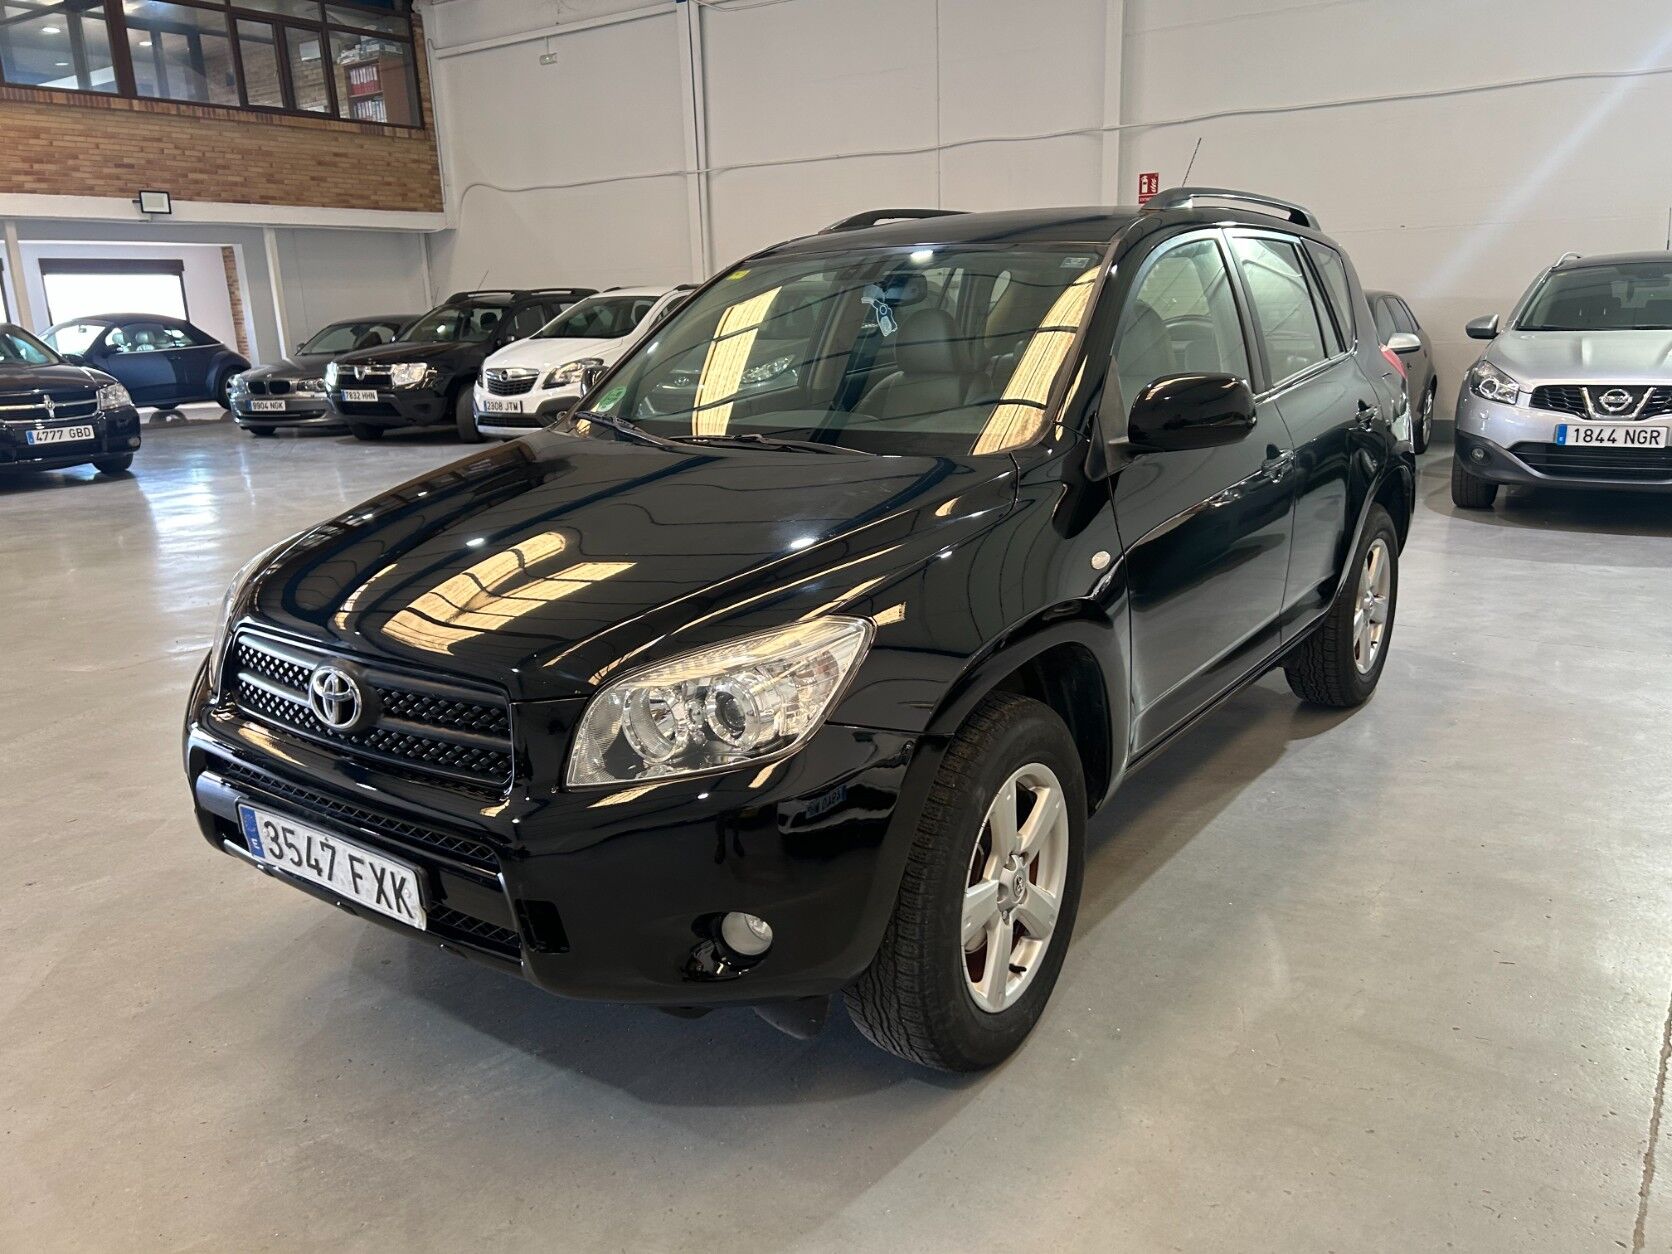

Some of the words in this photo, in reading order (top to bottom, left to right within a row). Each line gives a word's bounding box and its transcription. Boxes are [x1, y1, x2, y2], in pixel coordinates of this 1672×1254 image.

[487, 401, 503, 411] 2308
[505, 401, 518, 411] JTM
[36, 429, 64, 442] 4777
[68, 426, 92, 439] GBD
[1574, 428, 1617, 444] 1844
[1623, 429, 1661, 446] NGR
[263, 820, 336, 882] 3547
[348, 853, 414, 919] FXK
